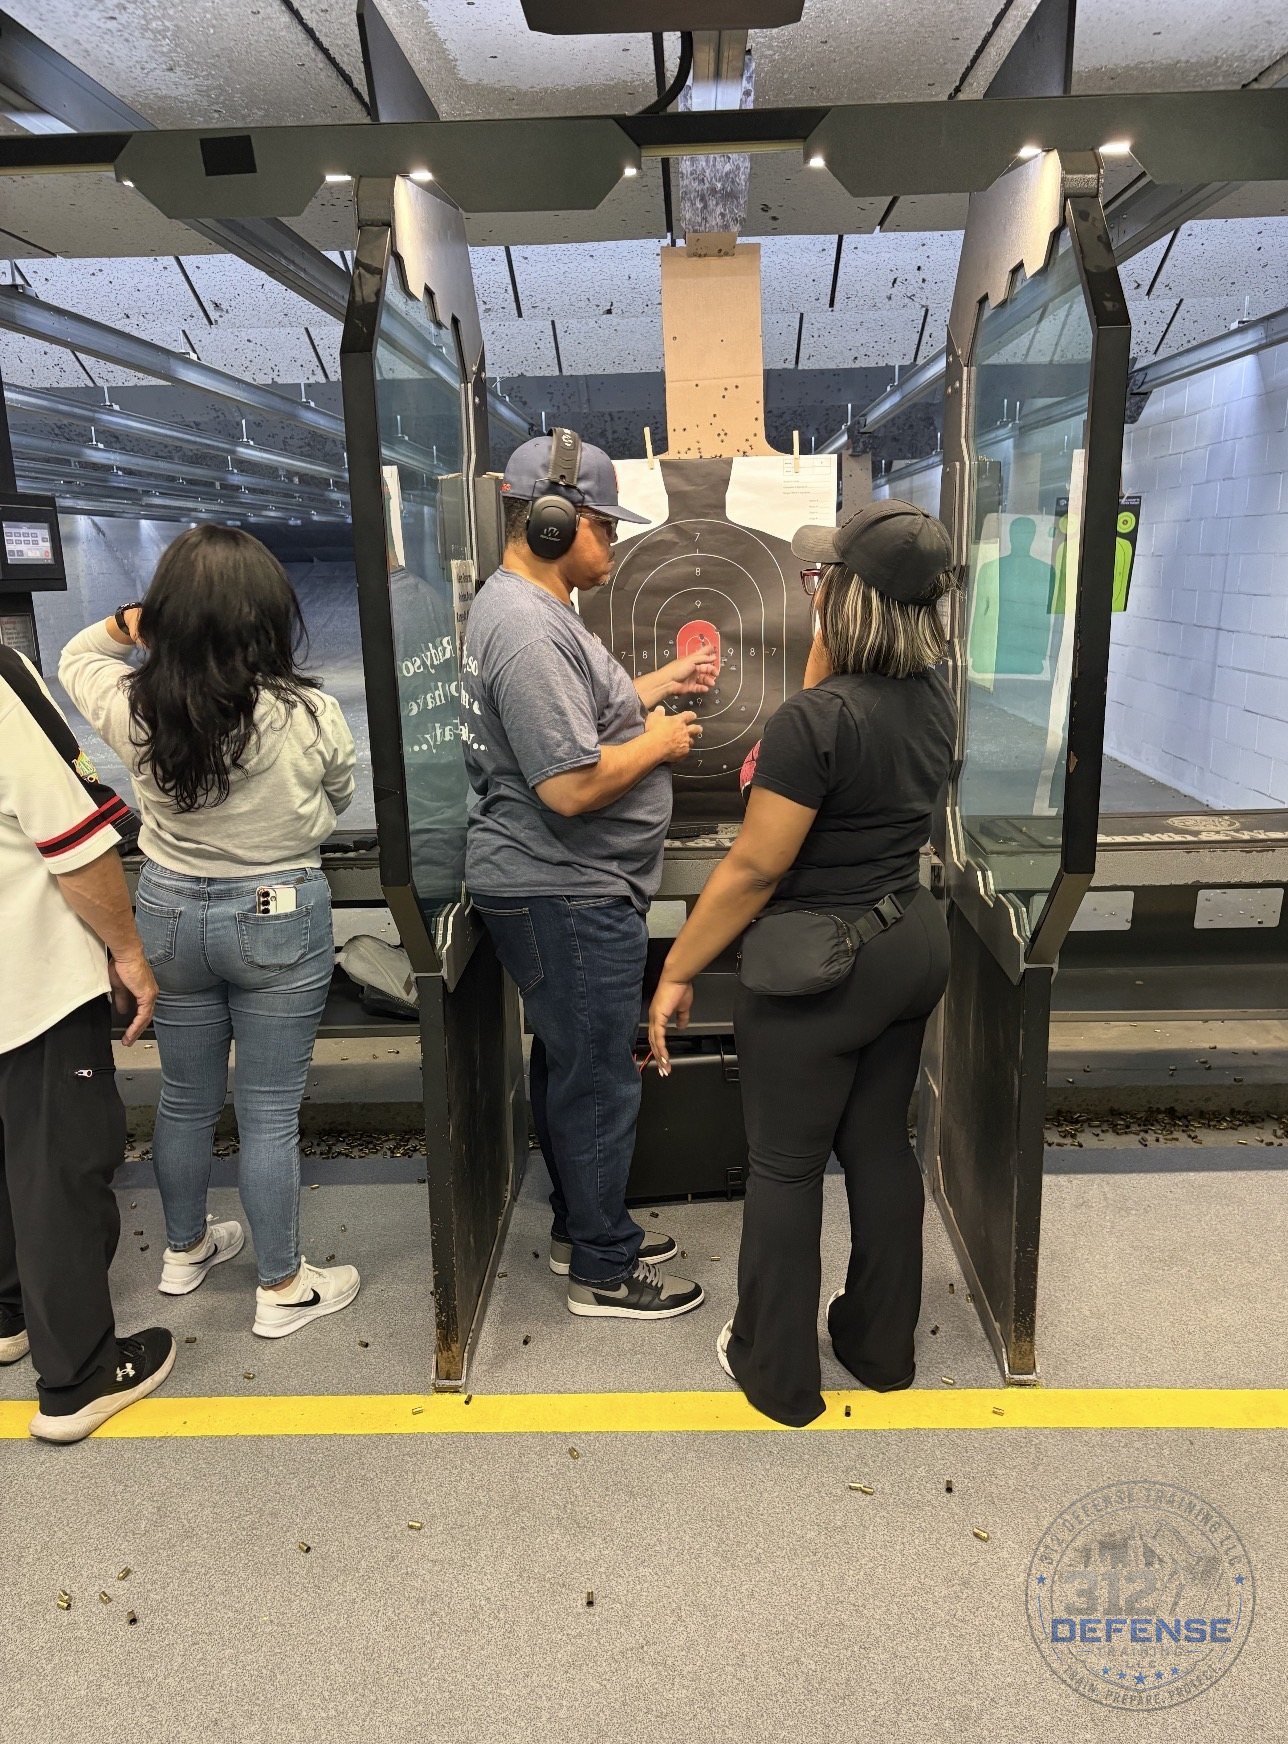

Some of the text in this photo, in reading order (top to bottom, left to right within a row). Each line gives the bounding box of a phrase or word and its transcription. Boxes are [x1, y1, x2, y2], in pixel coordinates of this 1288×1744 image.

[694, 532, 700, 542] 7
[695, 567, 701, 577] 8
[694, 599, 702, 609] 9
[620, 647, 777, 660] 7 8 9 9 8 7
